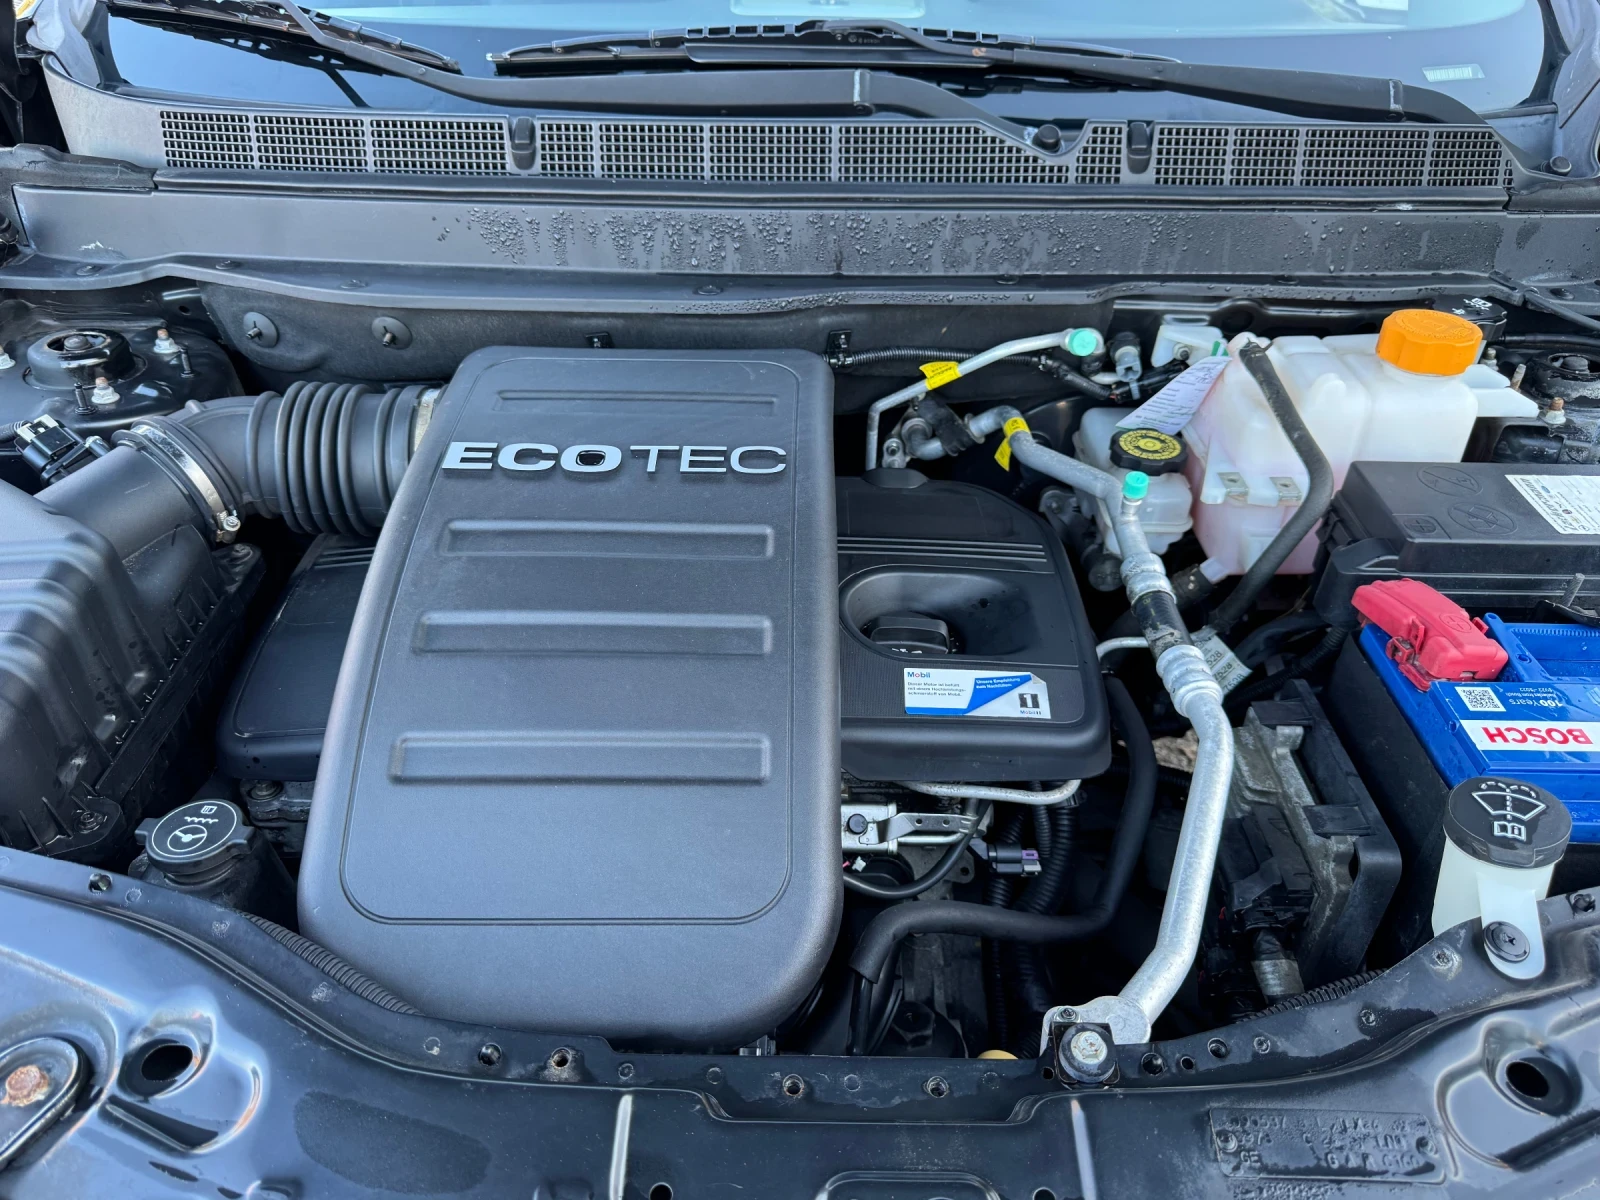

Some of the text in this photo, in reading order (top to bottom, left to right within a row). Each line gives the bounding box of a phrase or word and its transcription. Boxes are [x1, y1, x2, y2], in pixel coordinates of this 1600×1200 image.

[442, 441, 787, 474] ECOTEC
[1206, 650, 1223, 666] 528
[1539, 699, 1563, 707] 100
[1481, 727, 1594, 745] BOSCH
